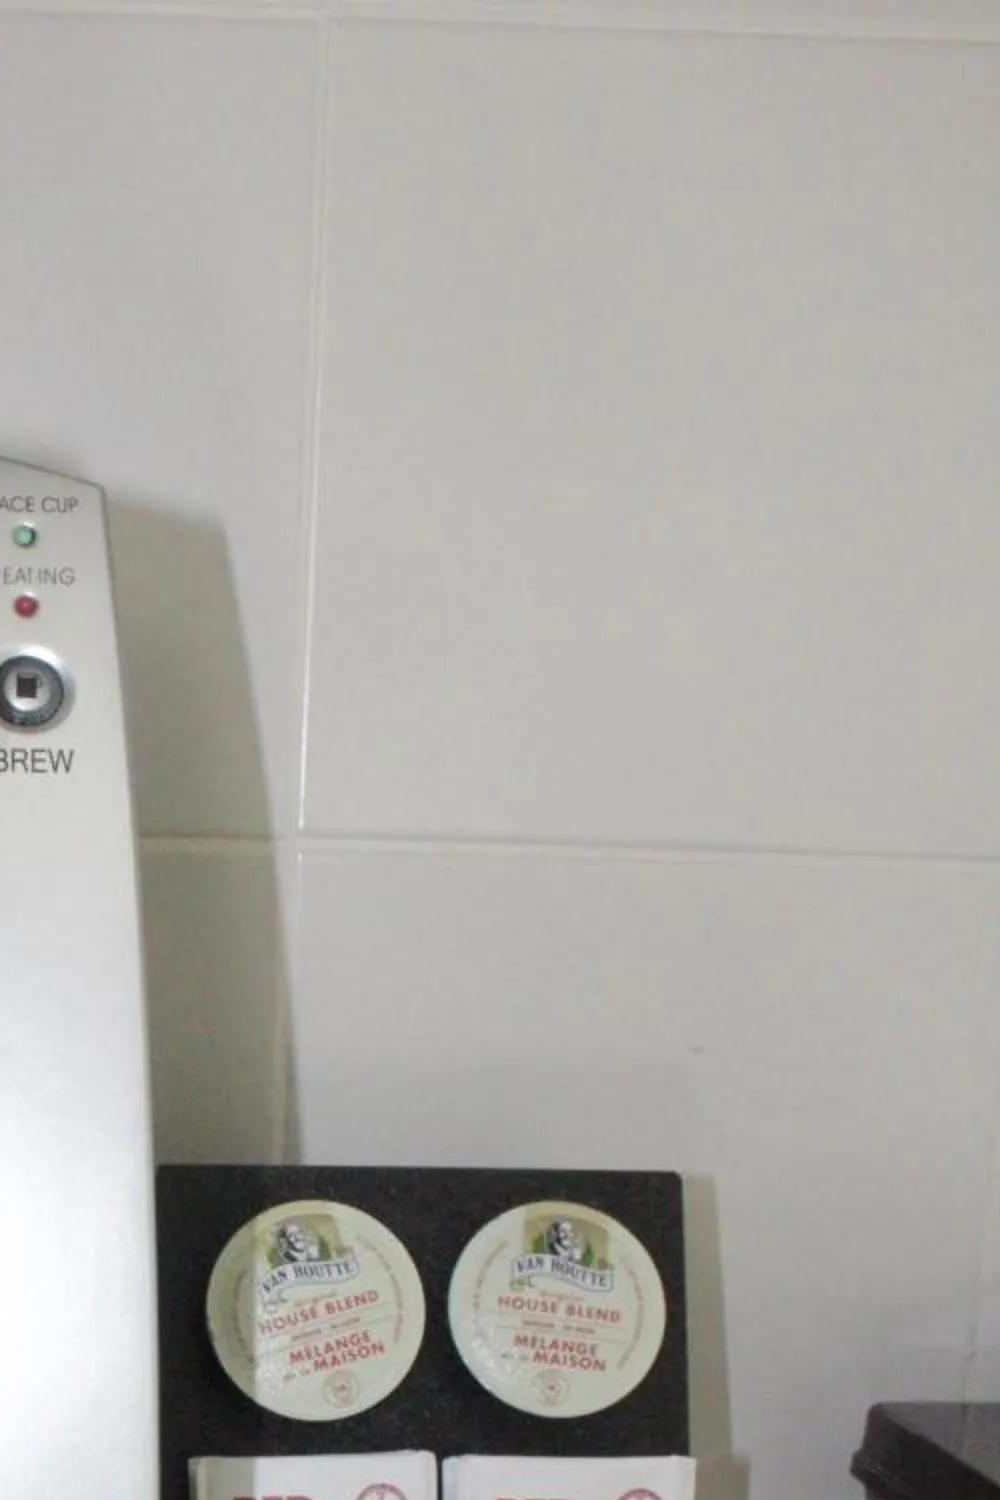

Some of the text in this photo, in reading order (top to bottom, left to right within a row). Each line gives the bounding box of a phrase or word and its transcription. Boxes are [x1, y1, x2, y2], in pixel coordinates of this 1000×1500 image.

[41, 496, 80, 513] CUP
[262, 1259, 355, 1294] VAN HOUTTE
[516, 1256, 544, 1273] VAN
[551, 1257, 608, 1288] HOUTTE
[259, 1306, 319, 1335] HOUSE
[325, 1289, 379, 1314] BLEND
[497, 1296, 620, 1323] HOUSE BLEND
[313, 1342, 384, 1373] MAISON
[533, 1350, 606, 1371] MAISON
